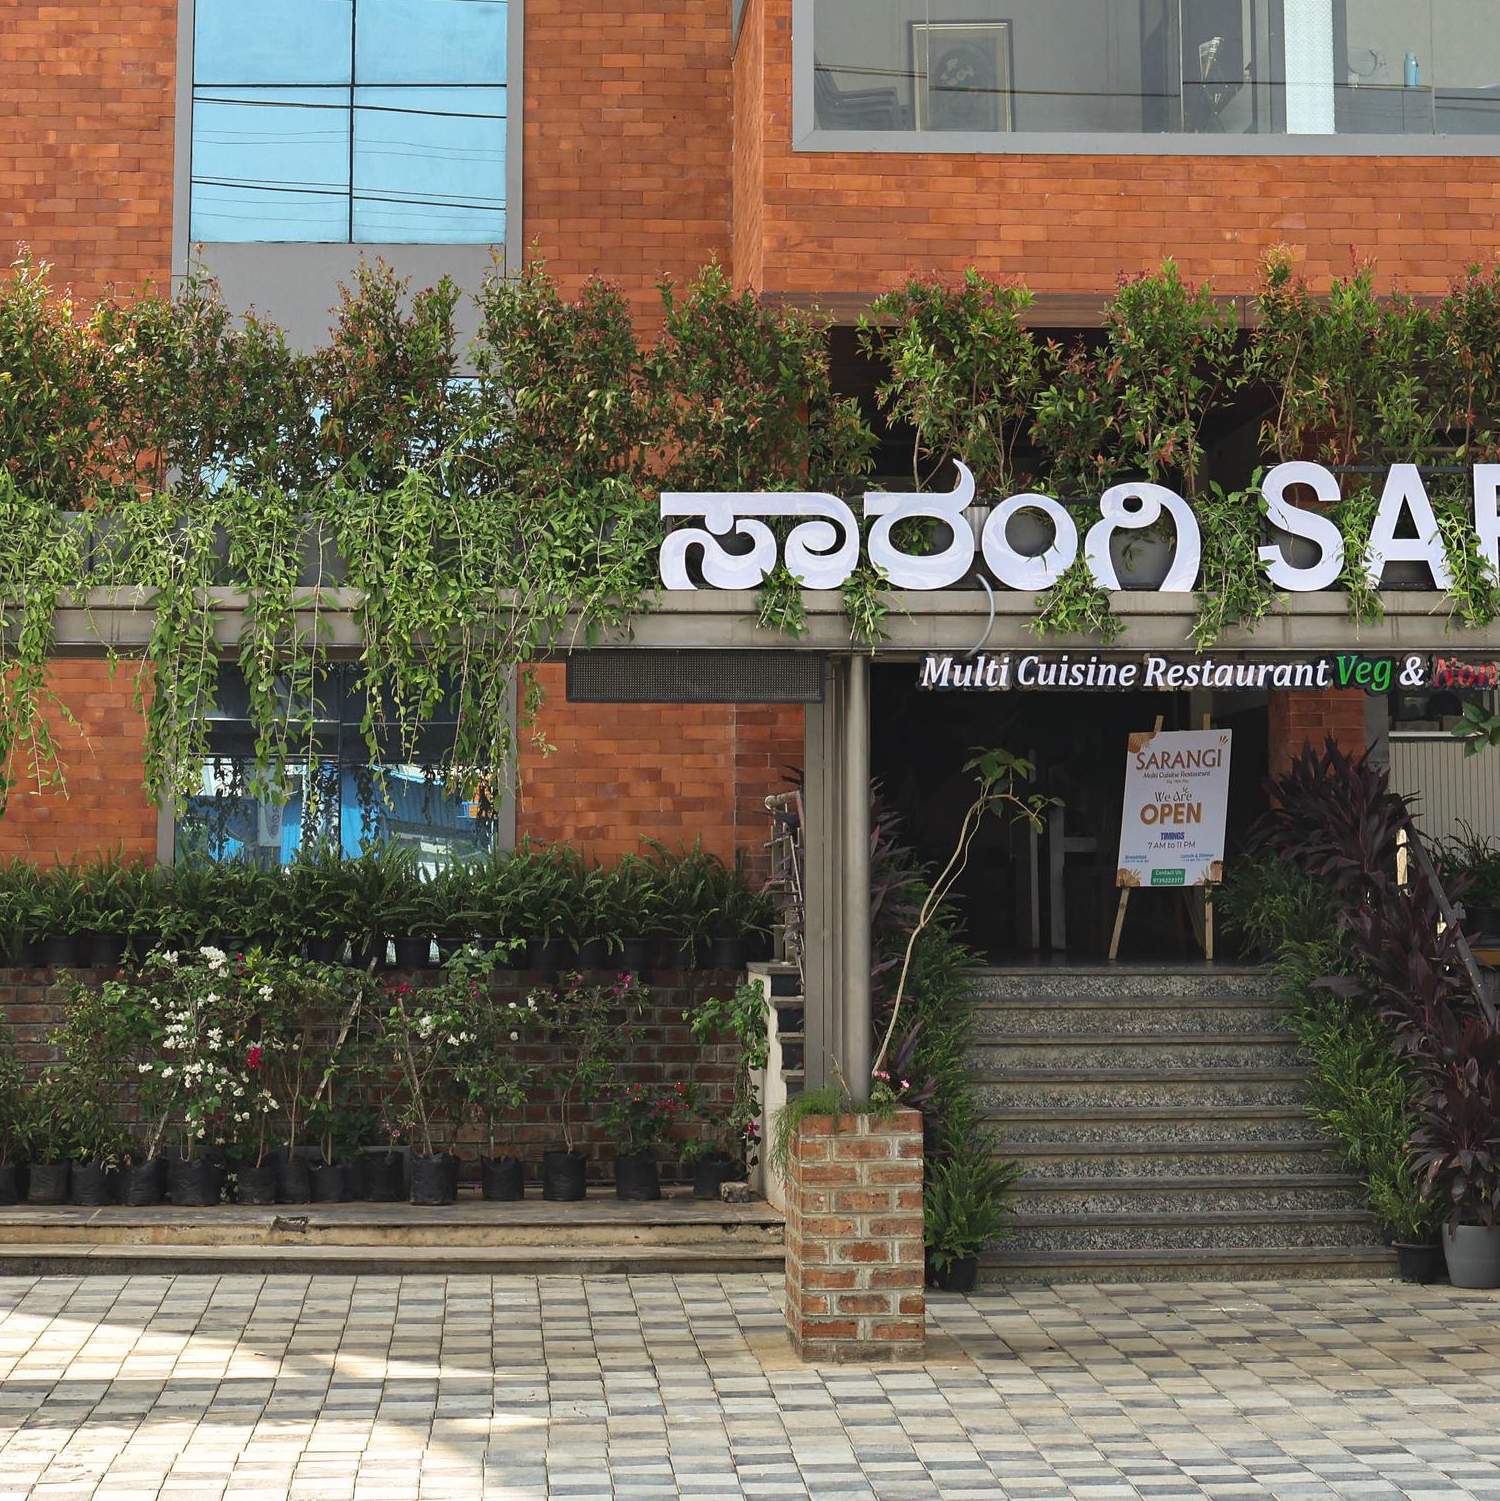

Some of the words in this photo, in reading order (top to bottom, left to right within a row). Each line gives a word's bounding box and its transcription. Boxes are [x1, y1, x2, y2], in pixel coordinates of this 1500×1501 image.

[659, 458, 1201, 592] ಸಾರಂಗಿ
[921, 656, 1011, 687] Multi
[1016, 655, 1137, 687] Cuisine
[1143, 656, 1330, 687] Restaurant
[1335, 654, 1393, 692] Veg
[1399, 655, 1425, 687] &
[1135, 749, 1222, 771] SARANGI
[1154, 791, 1171, 802] We
[1173, 790, 1193, 802] Are
[1139, 802, 1203, 826] OPEN
[1160, 831, 1185, 841] TIMINGS
[1177, 841, 1182, 849] 11
